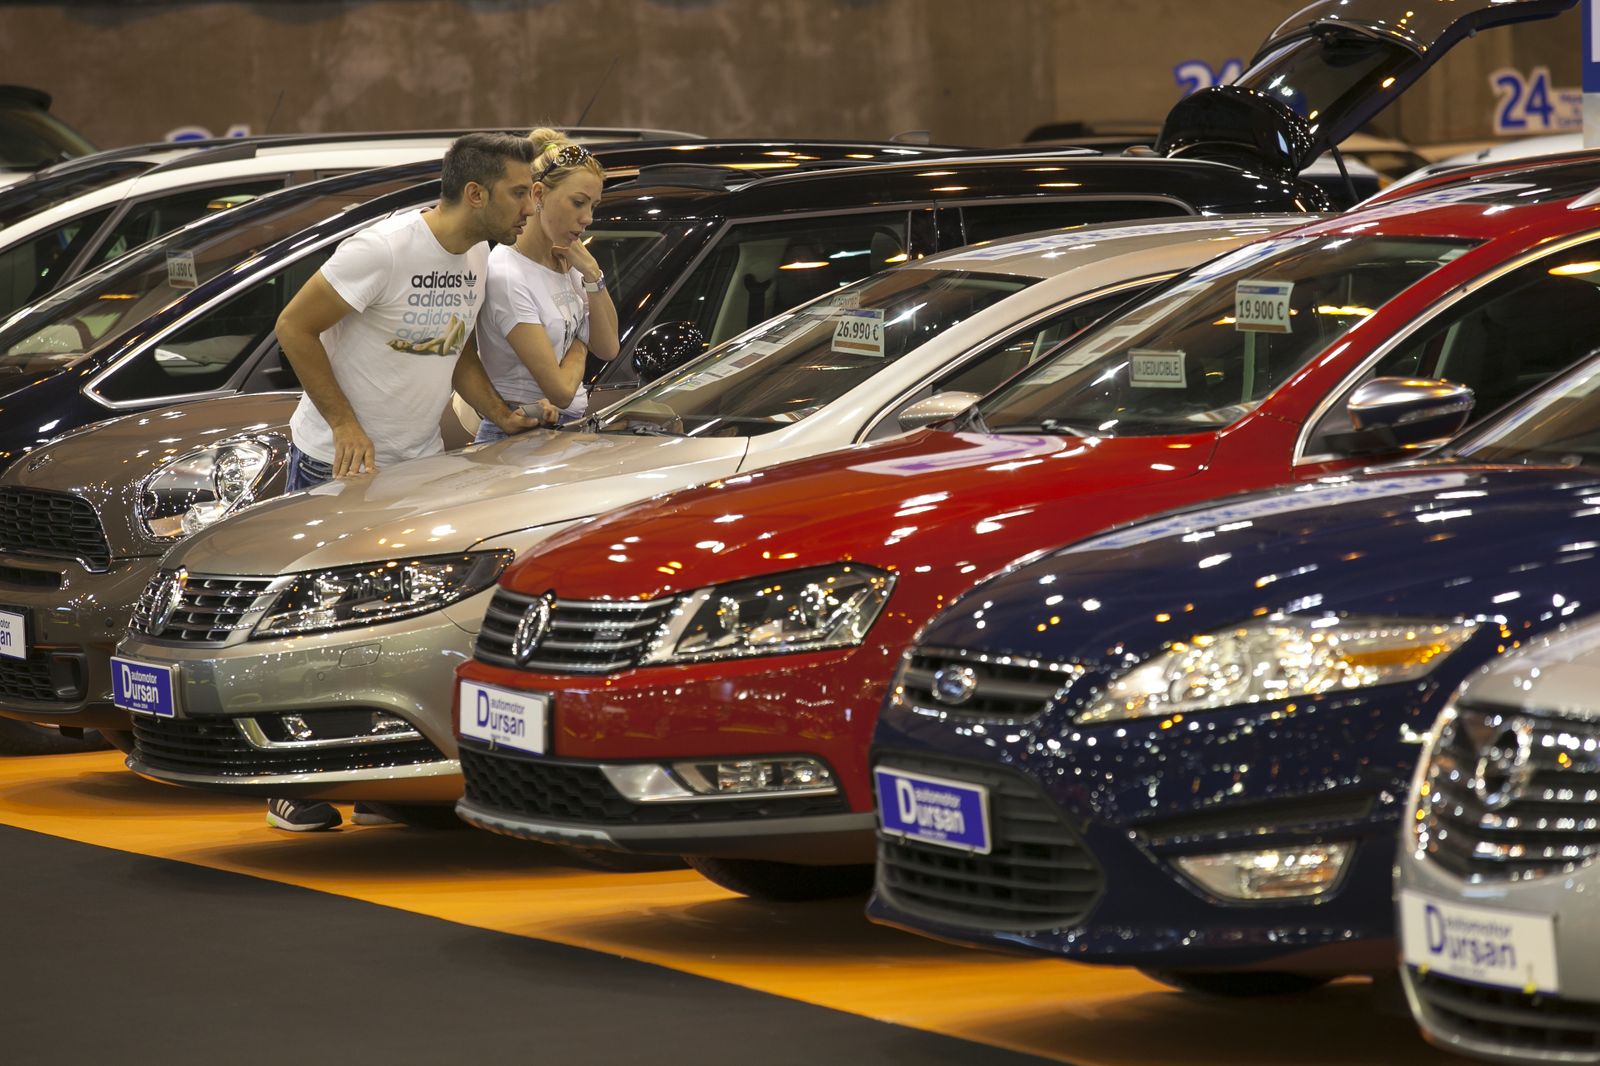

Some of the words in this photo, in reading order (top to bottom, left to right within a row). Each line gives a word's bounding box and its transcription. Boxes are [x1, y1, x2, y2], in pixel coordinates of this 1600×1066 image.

[1494, 70, 1556, 131] 24
[411, 271, 462, 289] adidas
[407, 290, 461, 307] adidas
[402, 309, 460, 326] adida
[1239, 300, 1274, 320] 19.900
[1277, 301, 1285, 321] €
[395, 327, 445, 341] adid
[837, 321, 871, 340] 26.990
[873, 324, 880, 341] €
[1142, 361, 1180, 377] DEDUCIBLE
[121, 663, 160, 704] Dursan
[131, 670, 158, 685] automotor
[477, 689, 526, 738] Dursan
[491, 699, 526, 715] automotor
[895, 778, 966, 835] Dursan
[1425, 903, 1517, 971] Dursan
